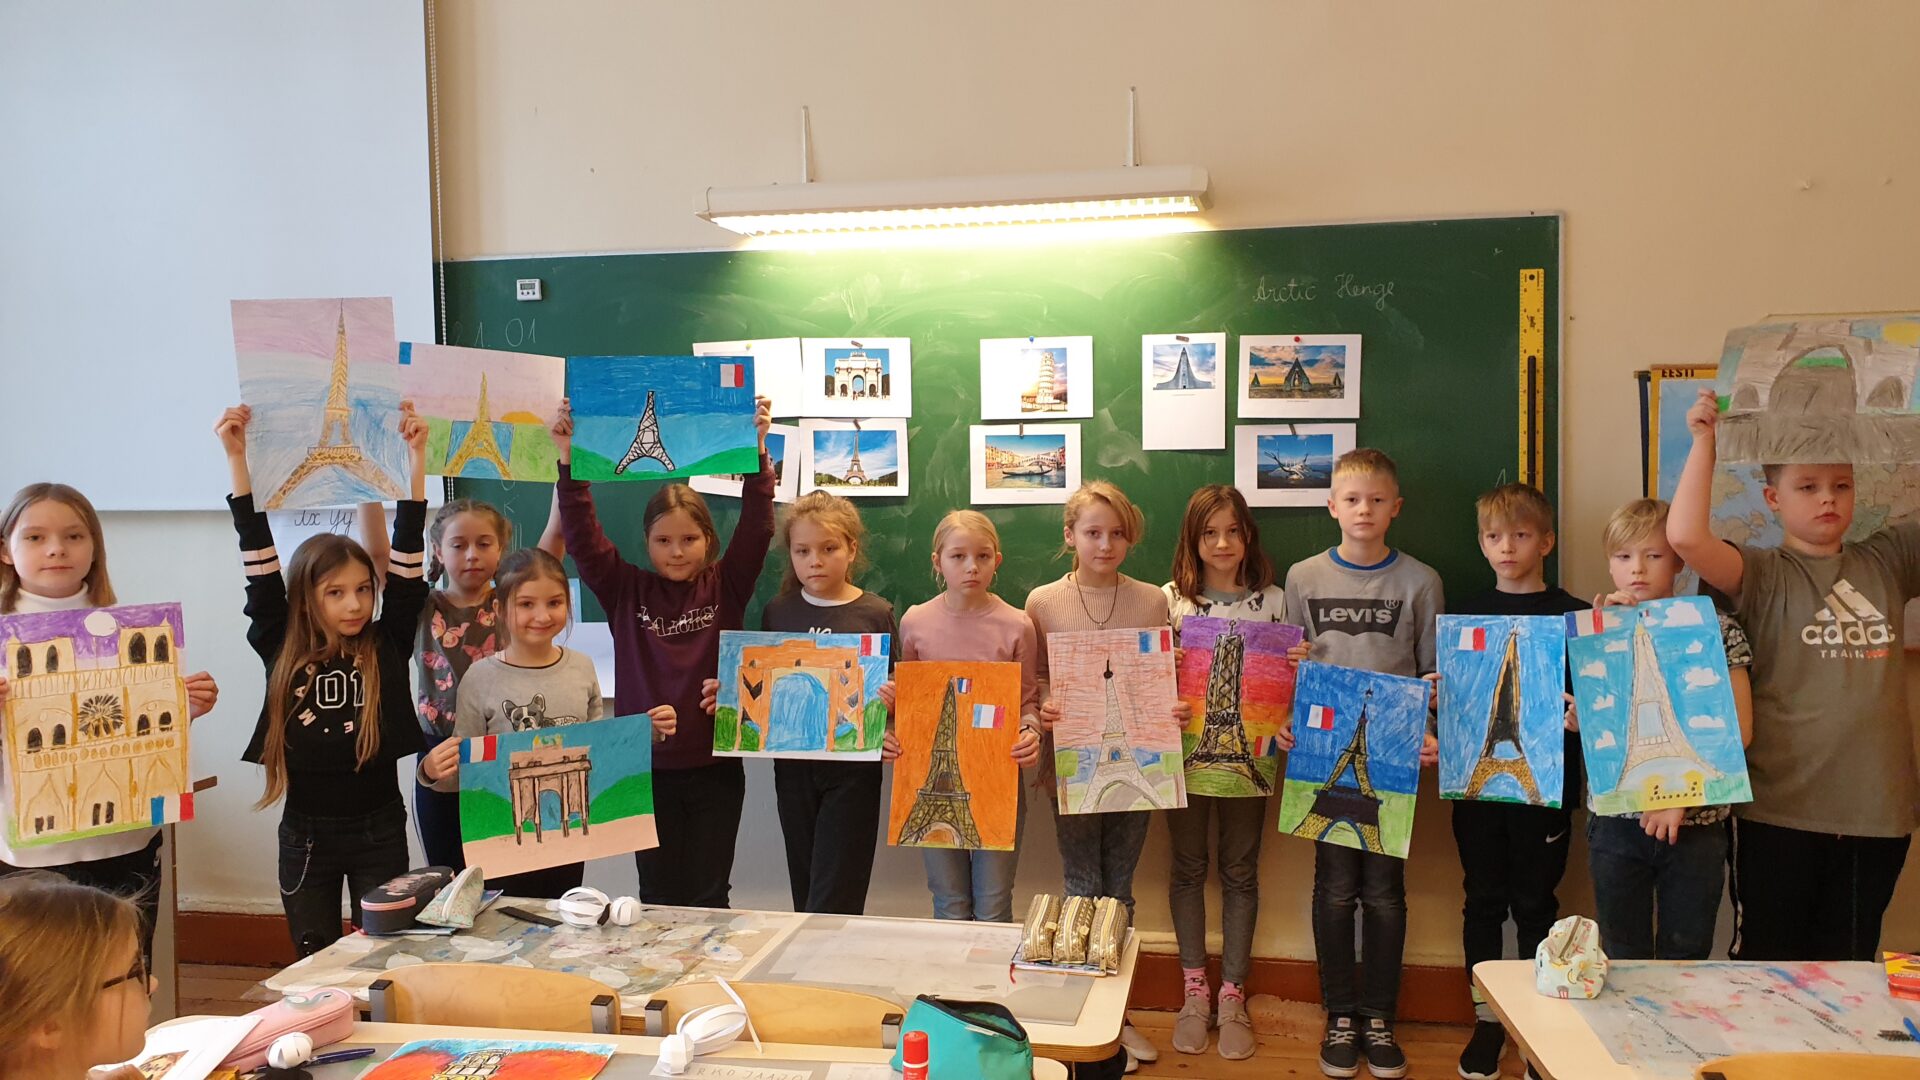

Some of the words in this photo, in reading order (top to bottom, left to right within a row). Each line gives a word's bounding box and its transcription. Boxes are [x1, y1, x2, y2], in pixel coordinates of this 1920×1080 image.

[1252, 276, 1316, 302] Arctic
[1334, 273, 1394, 311] Henge
[1661, 368, 1695, 378] EESTI
[1801, 620, 1896, 646] addas
